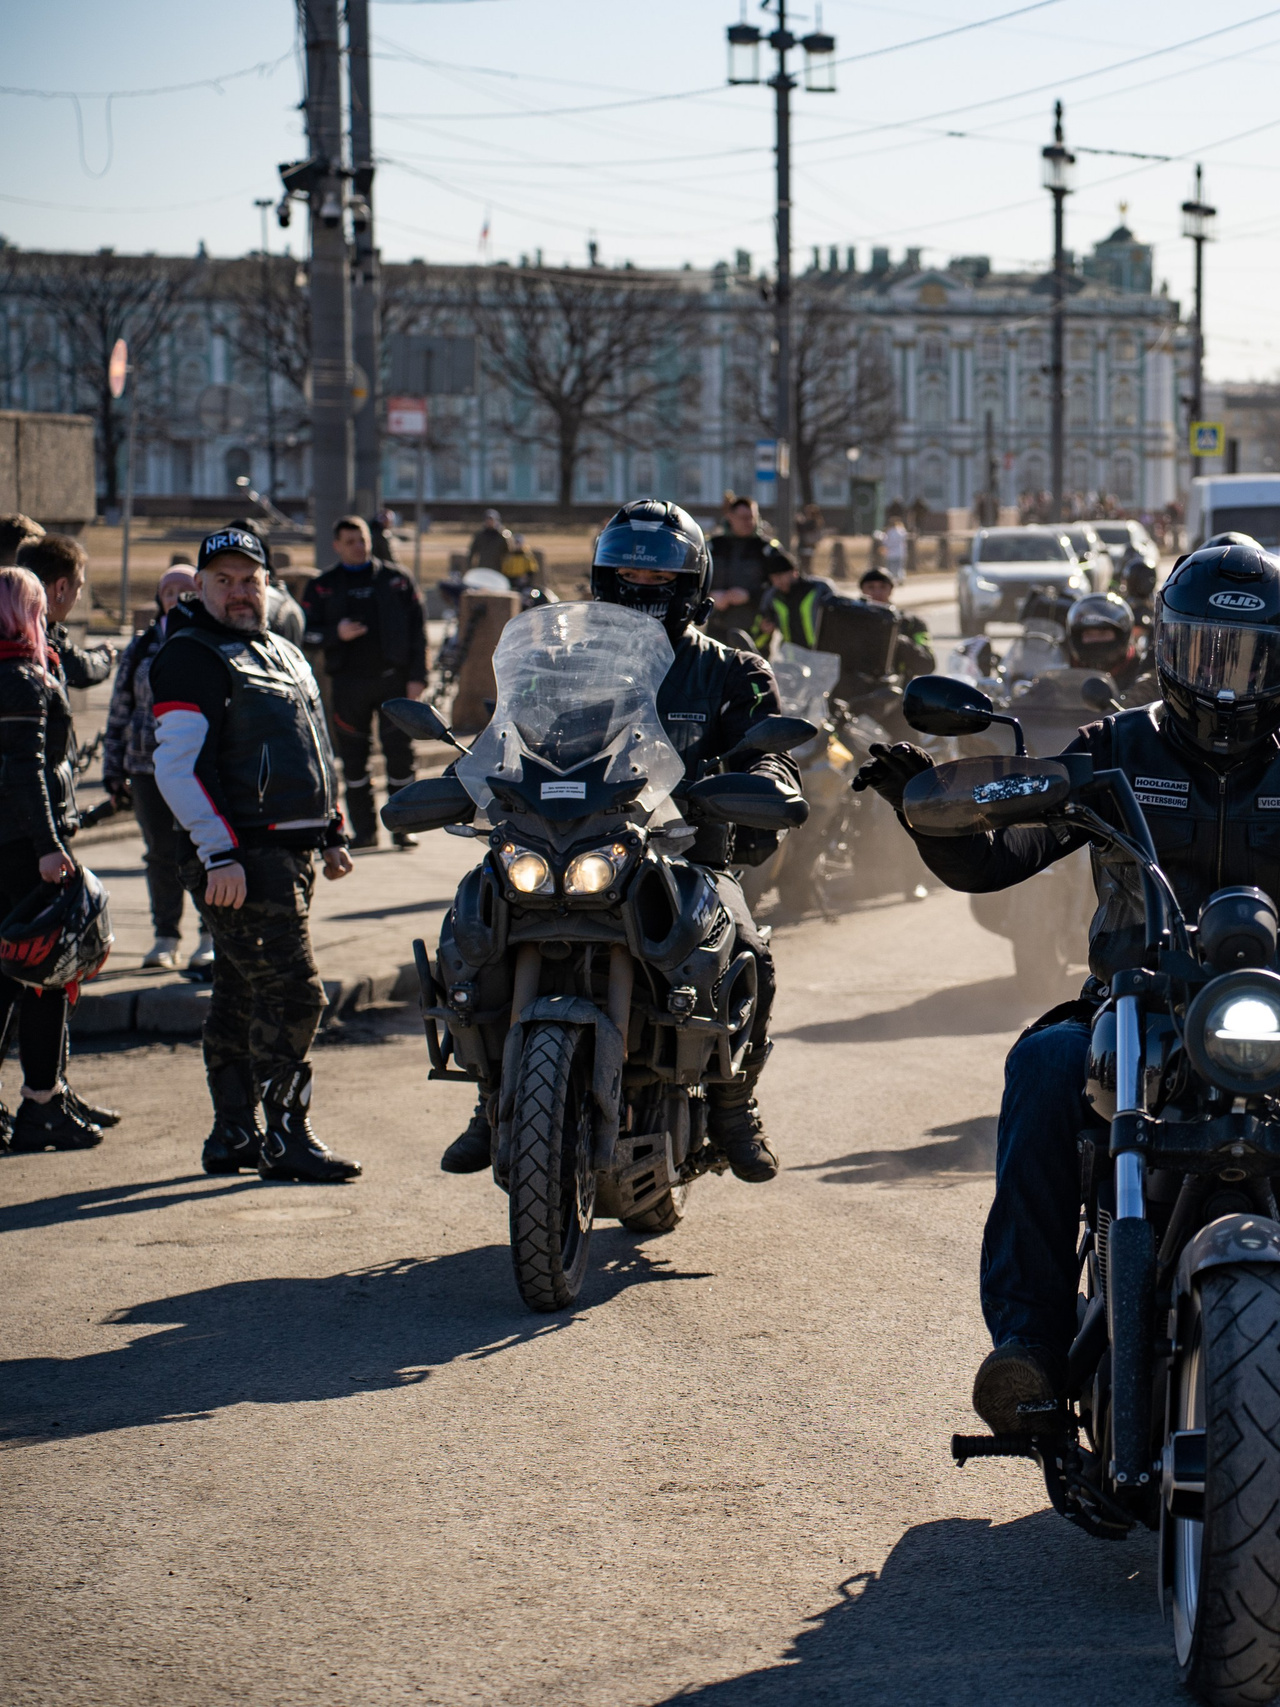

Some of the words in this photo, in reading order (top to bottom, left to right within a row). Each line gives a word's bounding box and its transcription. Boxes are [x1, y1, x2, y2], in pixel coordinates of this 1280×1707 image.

[205, 532, 253, 555] NRMC
[622, 553, 658, 562] SHARK
[1216, 595, 1259, 607] HJC
[670, 713, 704, 721] MEMBER
[1136, 779, 1188, 790] HOOLIGANS
